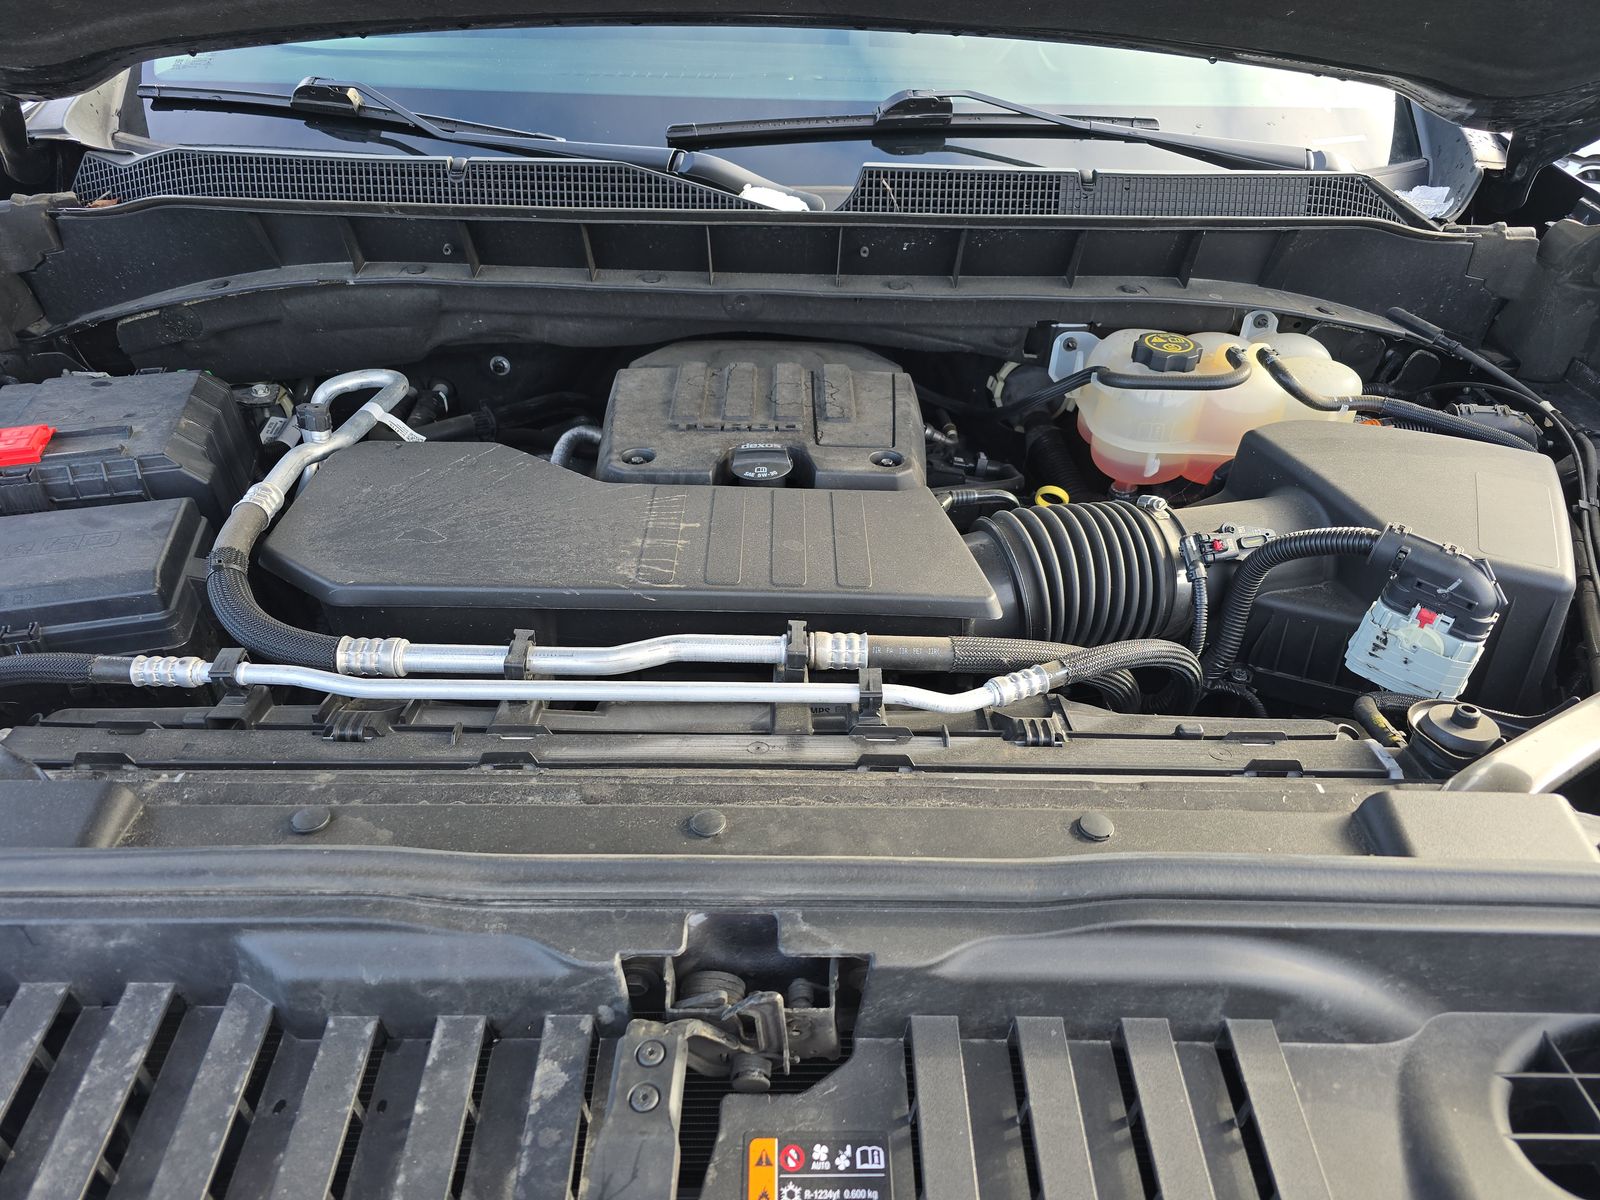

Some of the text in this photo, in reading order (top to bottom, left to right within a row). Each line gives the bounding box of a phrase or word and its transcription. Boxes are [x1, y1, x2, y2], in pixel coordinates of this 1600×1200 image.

[811, 1161, 831, 1170] AUTO
[804, 1188, 878, 1200] R-1234yf 0.600 kg
